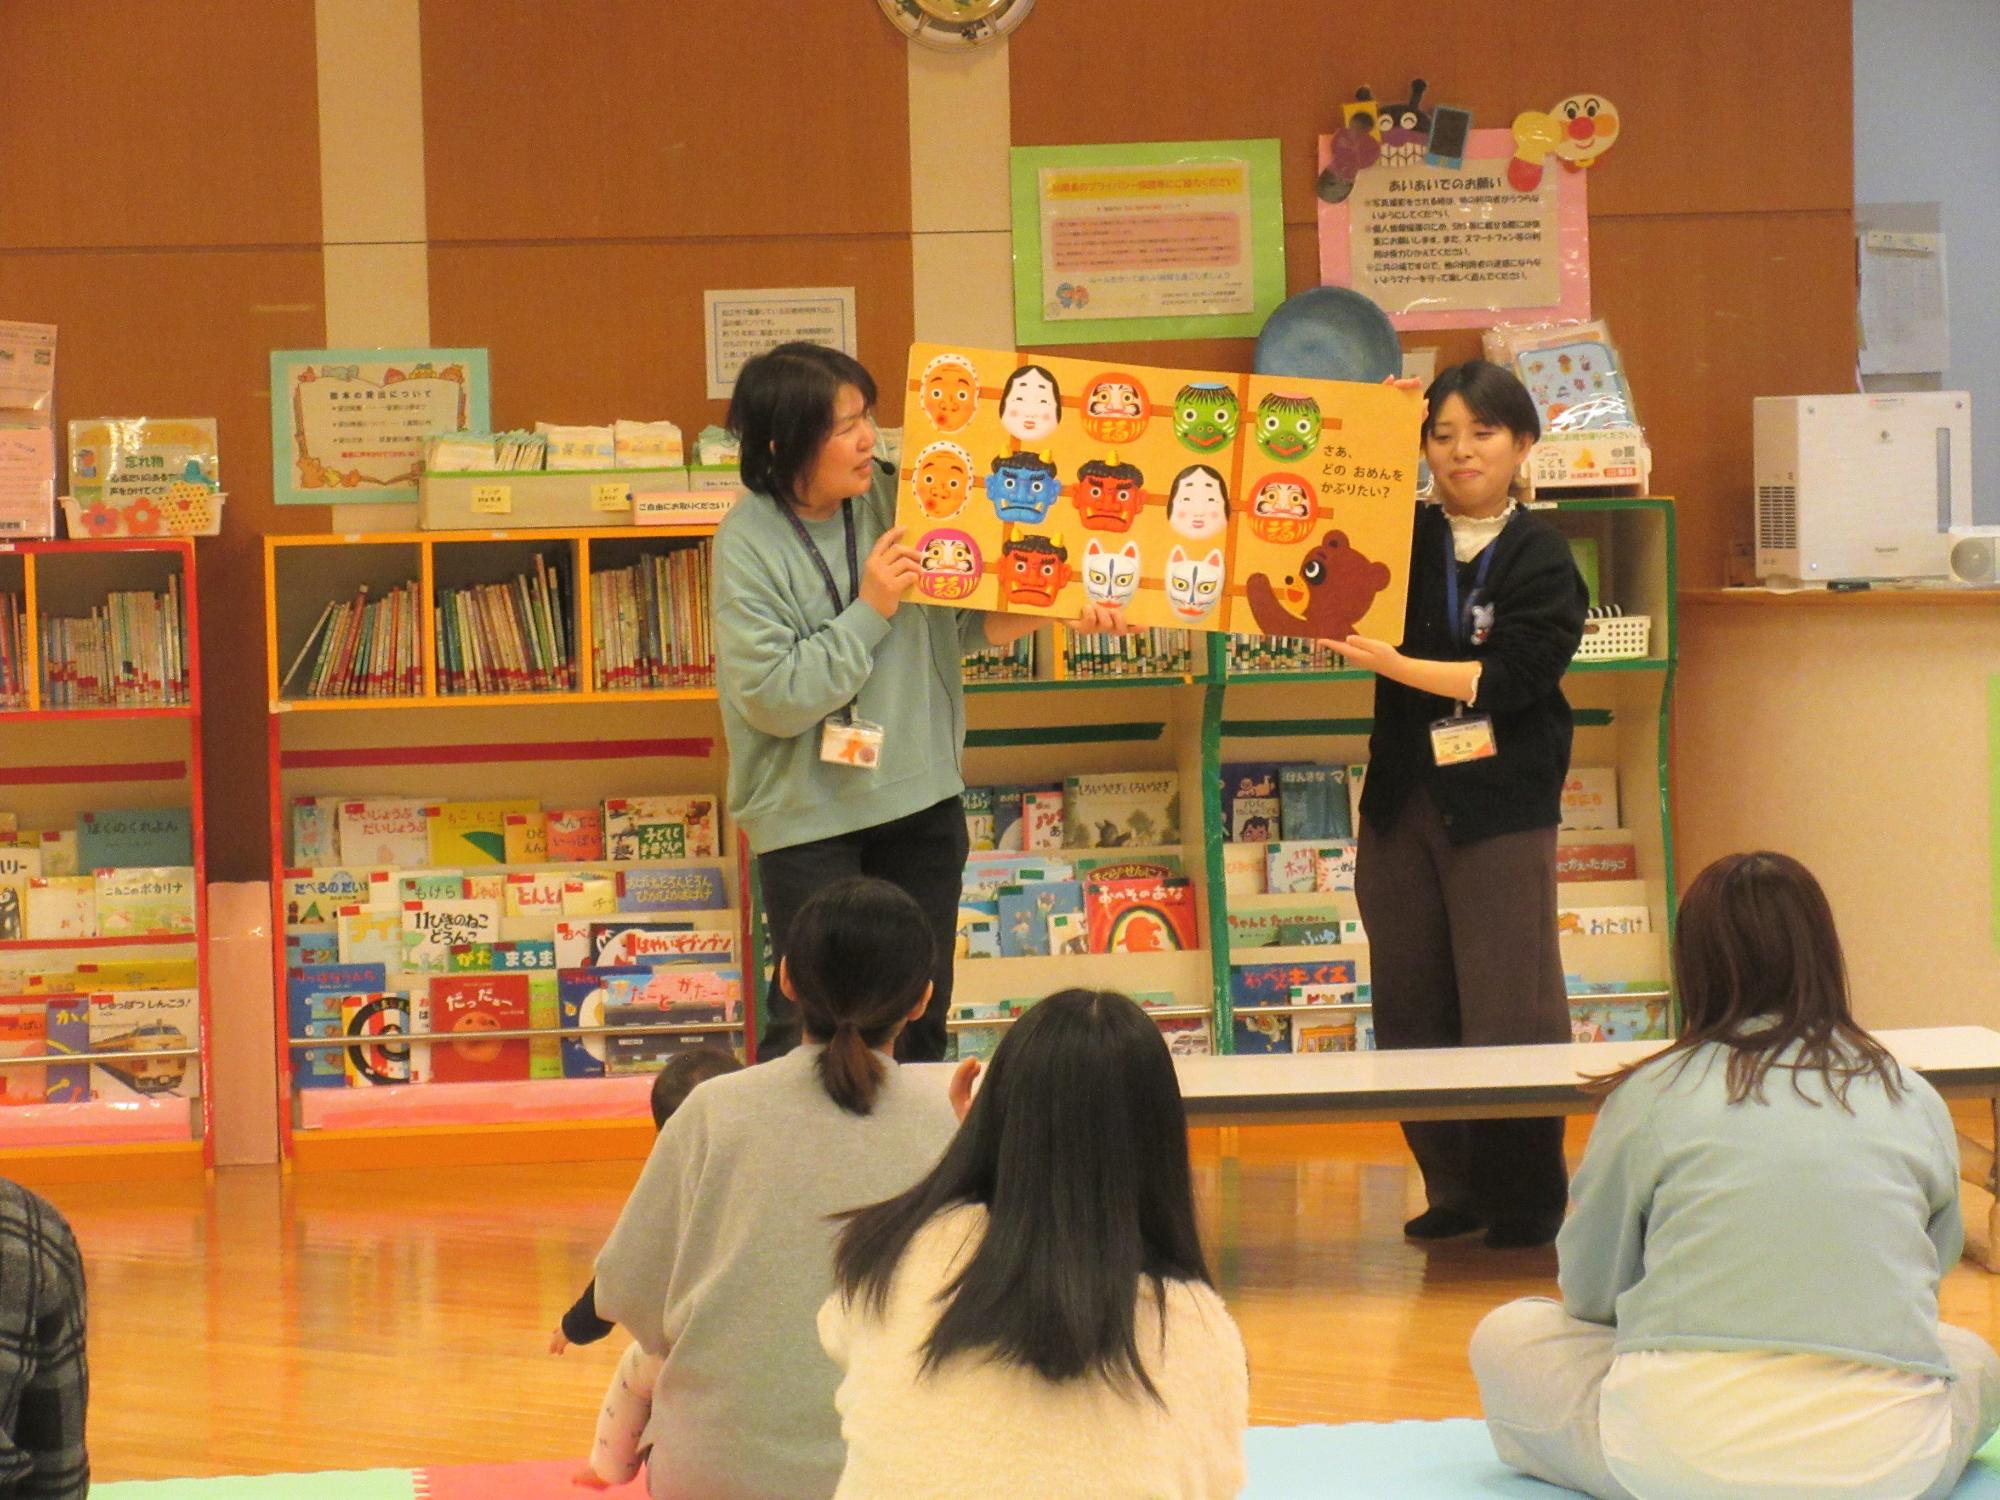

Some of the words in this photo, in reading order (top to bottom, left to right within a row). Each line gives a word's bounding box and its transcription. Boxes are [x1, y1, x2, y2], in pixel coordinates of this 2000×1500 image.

[1389, 177, 1501, 192] あいあいでのお願い
[1102, 420, 1128, 441] 福
[1323, 445, 1353, 459] さあ、
[125, 456, 164, 468] 忘れ物
[1322, 463, 1347, 476] どの
[1353, 466, 1404, 482] おめんを
[1321, 482, 1390, 499] かぶりたい?
[1267, 520, 1296, 541] 福
[932, 577, 961, 598] 福
[1079, 781, 1171, 796] しろいうさぎとくろいうさぎ
[416, 912, 489, 930] 11ぴきのねこ
[430, 928, 477, 945] どろんこ
[148, 998, 192, 1010] しんこう!
